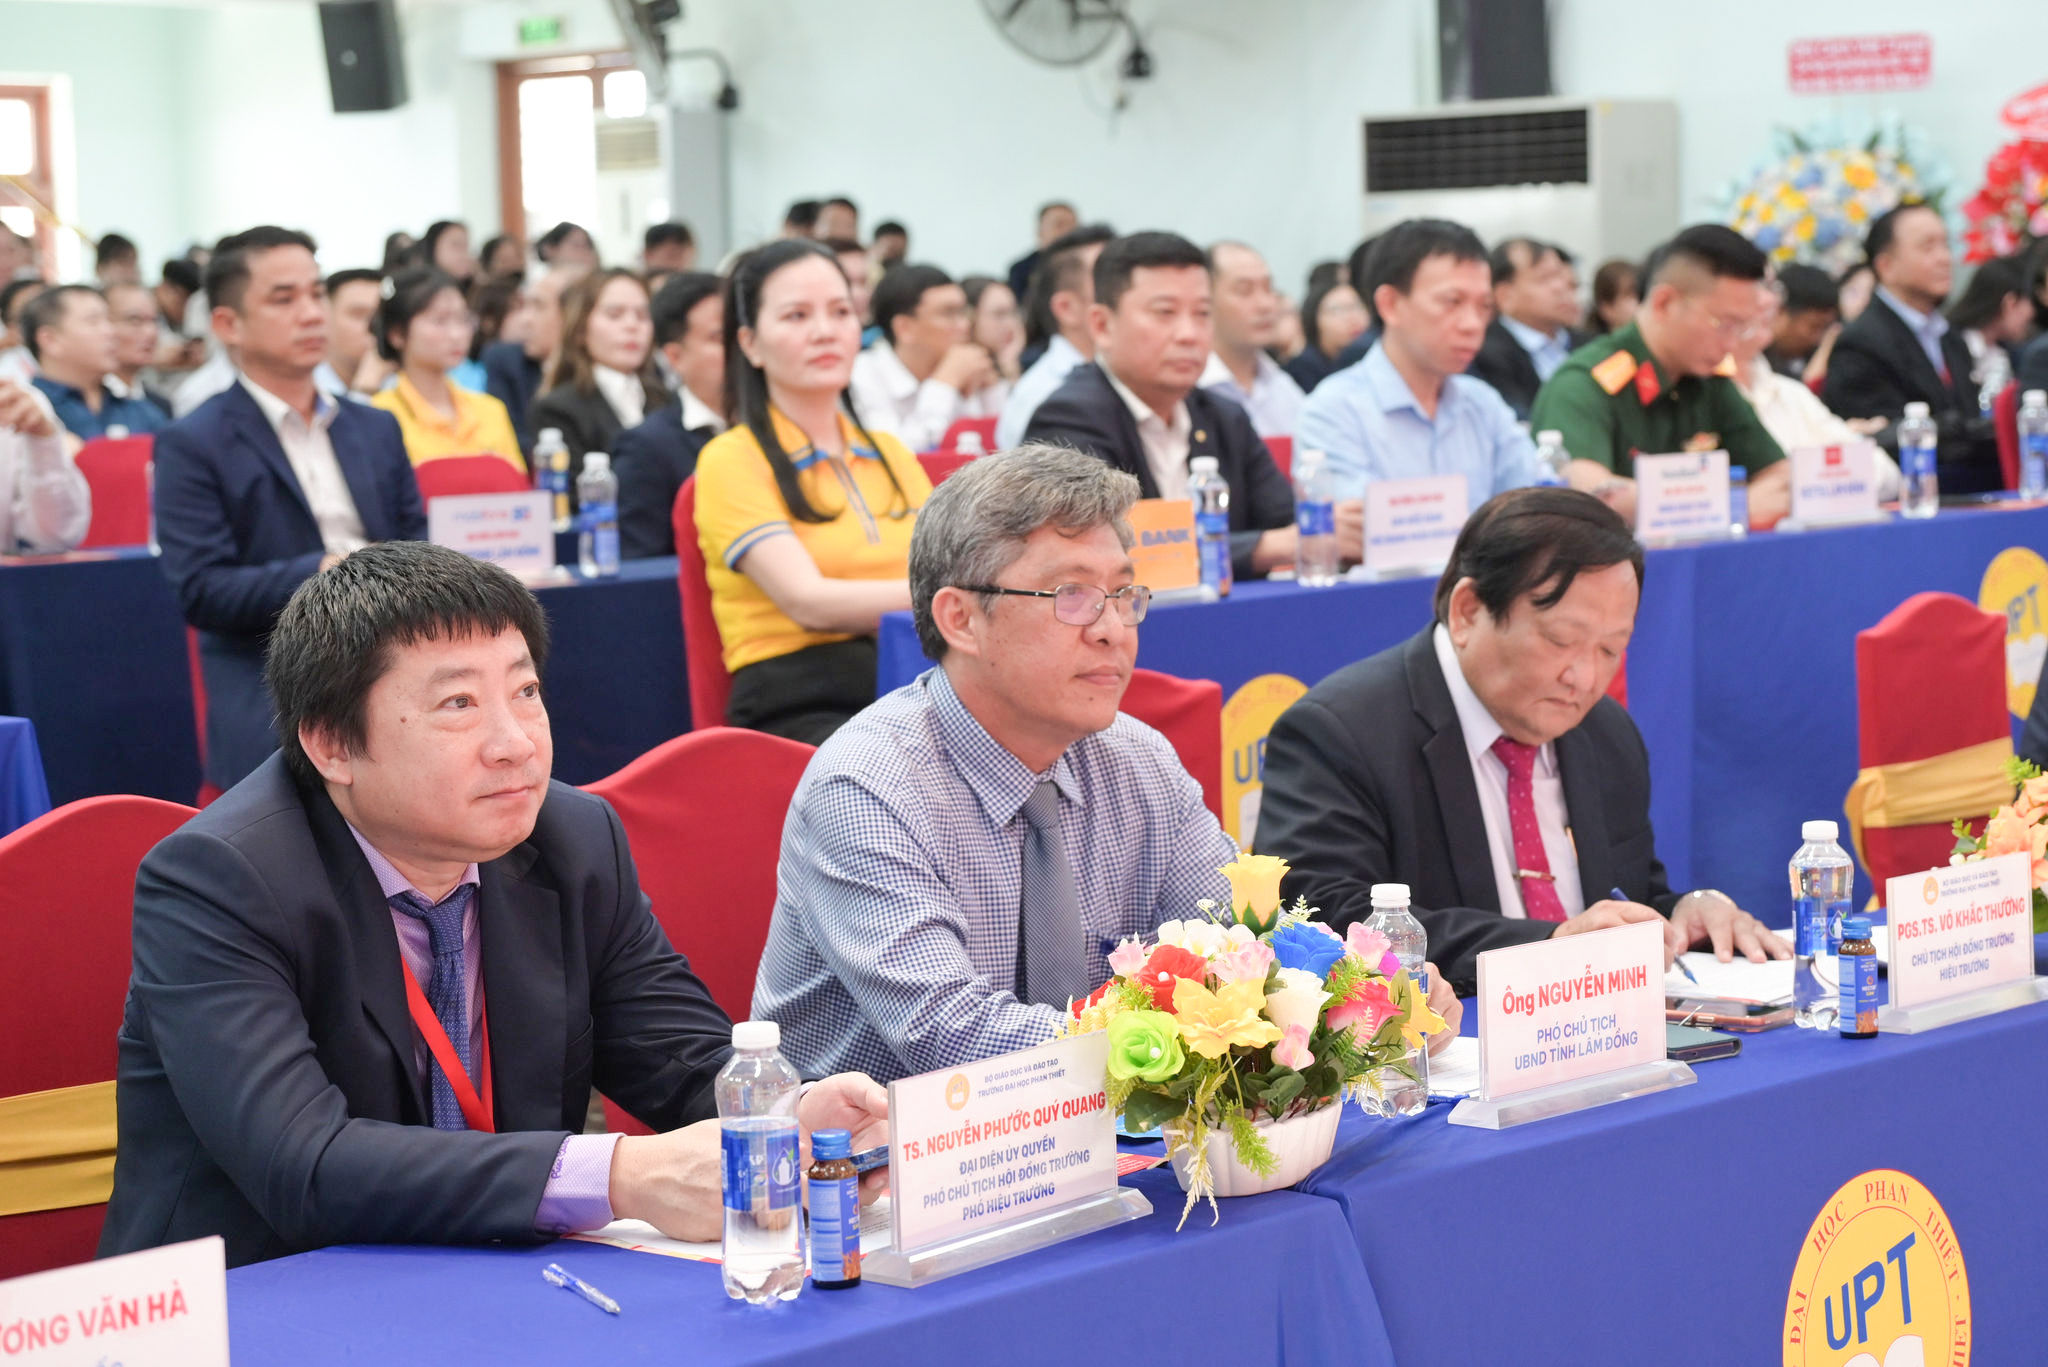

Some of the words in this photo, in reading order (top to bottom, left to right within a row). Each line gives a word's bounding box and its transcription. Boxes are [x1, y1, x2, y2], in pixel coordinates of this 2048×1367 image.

[2008, 584, 2039, 633] PT
[1940, 909, 1953, 931] VÕ
[1912, 949, 1928, 966] CHỦ
[1930, 947, 1946, 964] TỊCH
[1949, 942, 1961, 959] HỘI
[1963, 937, 1984, 955] ĐỒNG
[1986, 932, 2014, 950] TRƯỜNG
[1940, 965, 1957, 981] HIỆU
[1959, 959, 1989, 975] TRƯỜNG
[1503, 985, 1534, 1016] Ông
[1539, 964, 1604, 1007] NGUYỄN
[1608, 965, 1647, 993] MINH
[1515, 1051, 1547, 1070] UBND
[1550, 1042, 1575, 1062] TỈNH
[1578, 1037, 1602, 1057] LÂM
[1605, 1027, 1638, 1050] ĐỒNG
[1537, 1021, 1561, 1043] PHÓ
[1564, 1015, 1587, 1037] CHỦ
[1590, 1014, 1616, 1035] TỊCH
[1031, 1074, 1047, 1083] PHAN
[1048, 1069, 1065, 1080] THIẾT
[903, 1142, 924, 1161] TS.
[927, 1120, 981, 1156] NGUYỄN
[984, 1107, 1030, 1140] PHƯỚC
[1033, 1099, 1060, 1126] QUÝ
[1062, 1091, 1106, 1119] QUANG
[959, 1158, 977, 1176] ĐẠI
[980, 1150, 1003, 1170] DIỆN
[1006, 1144, 1018, 1162] ỦY
[1022, 1134, 1055, 1157] QUYỀN
[924, 1188, 945, 1208] PHÓ
[948, 1180, 969, 1201] CHỦ
[972, 1176, 995, 1196] TỊCH
[998, 1169, 1016, 1188] HỘI
[1018, 1161, 1047, 1181] ĐỒNG
[1049, 1149, 1090, 1172] TRƯỜNG
[963, 1199, 984, 1220] PHÓ
[987, 1193, 1010, 1215] HIỆU
[1013, 1182, 1055, 1206] TRƯỜNG
[1864, 1181, 1910, 1205] PHAN
[1925, 1207, 1960, 1282] THIẾT
[1824, 1231, 1916, 1351] UPT
[0, 1314, 70, 1354] ƠNG
[78, 1296, 138, 1337] VĂN
[148, 1280, 187, 1323] HÀ
